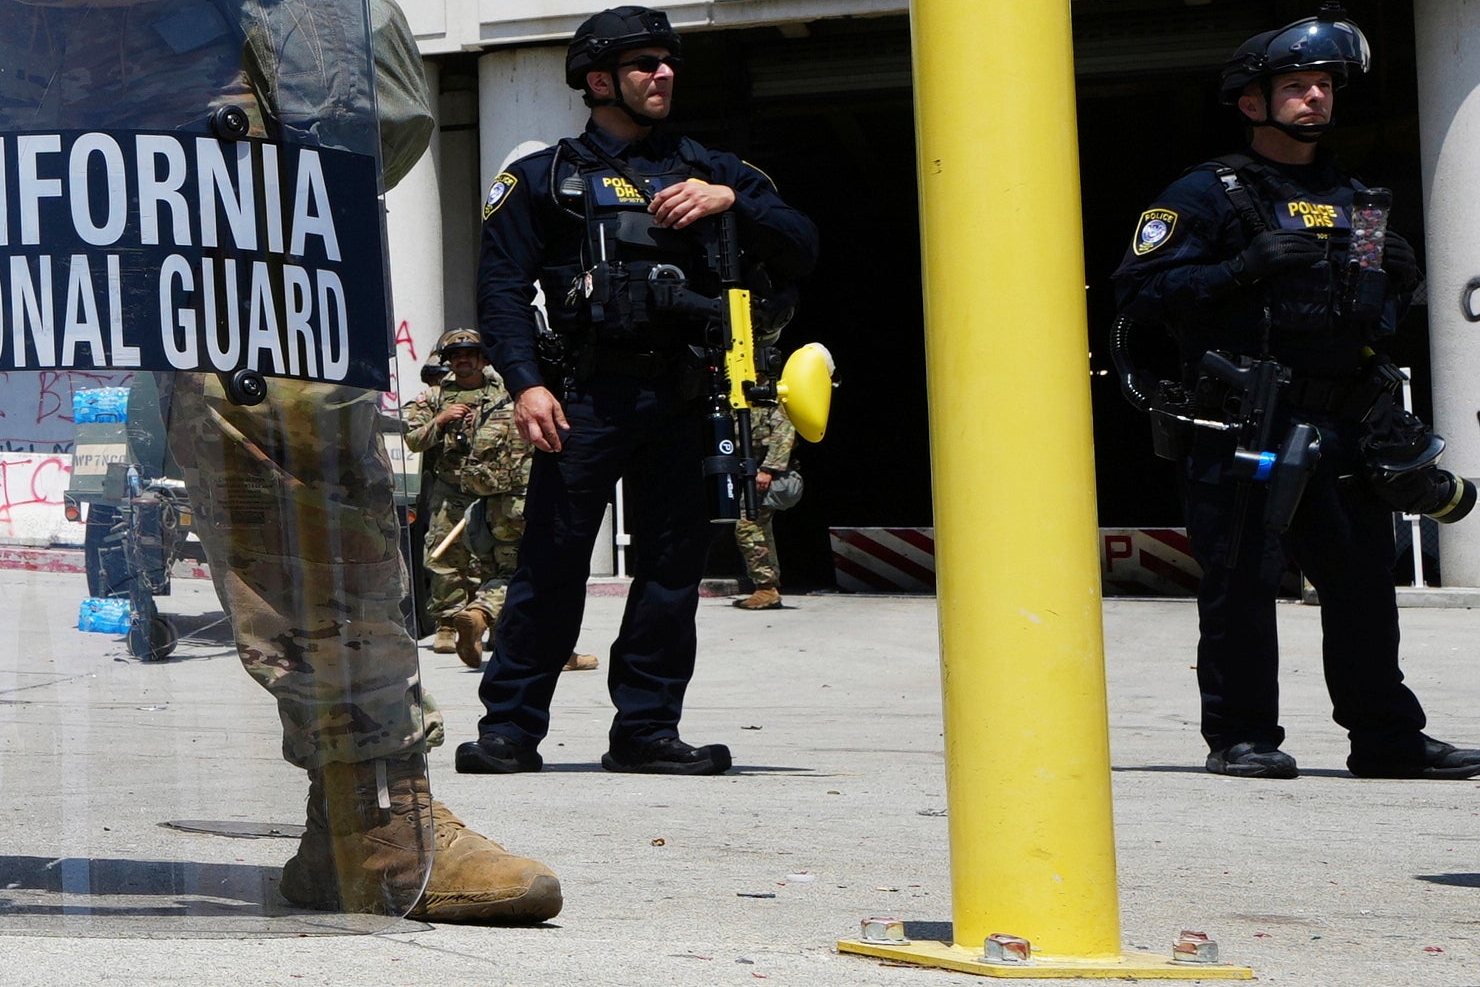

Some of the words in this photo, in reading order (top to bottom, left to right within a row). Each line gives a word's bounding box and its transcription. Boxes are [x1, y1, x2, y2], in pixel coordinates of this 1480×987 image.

[1287, 201, 1338, 218] POLICE
[1144, 213, 1174, 223] POLICE
[1303, 214, 1335, 228] DHS
[159, 253, 350, 382] GUARD
